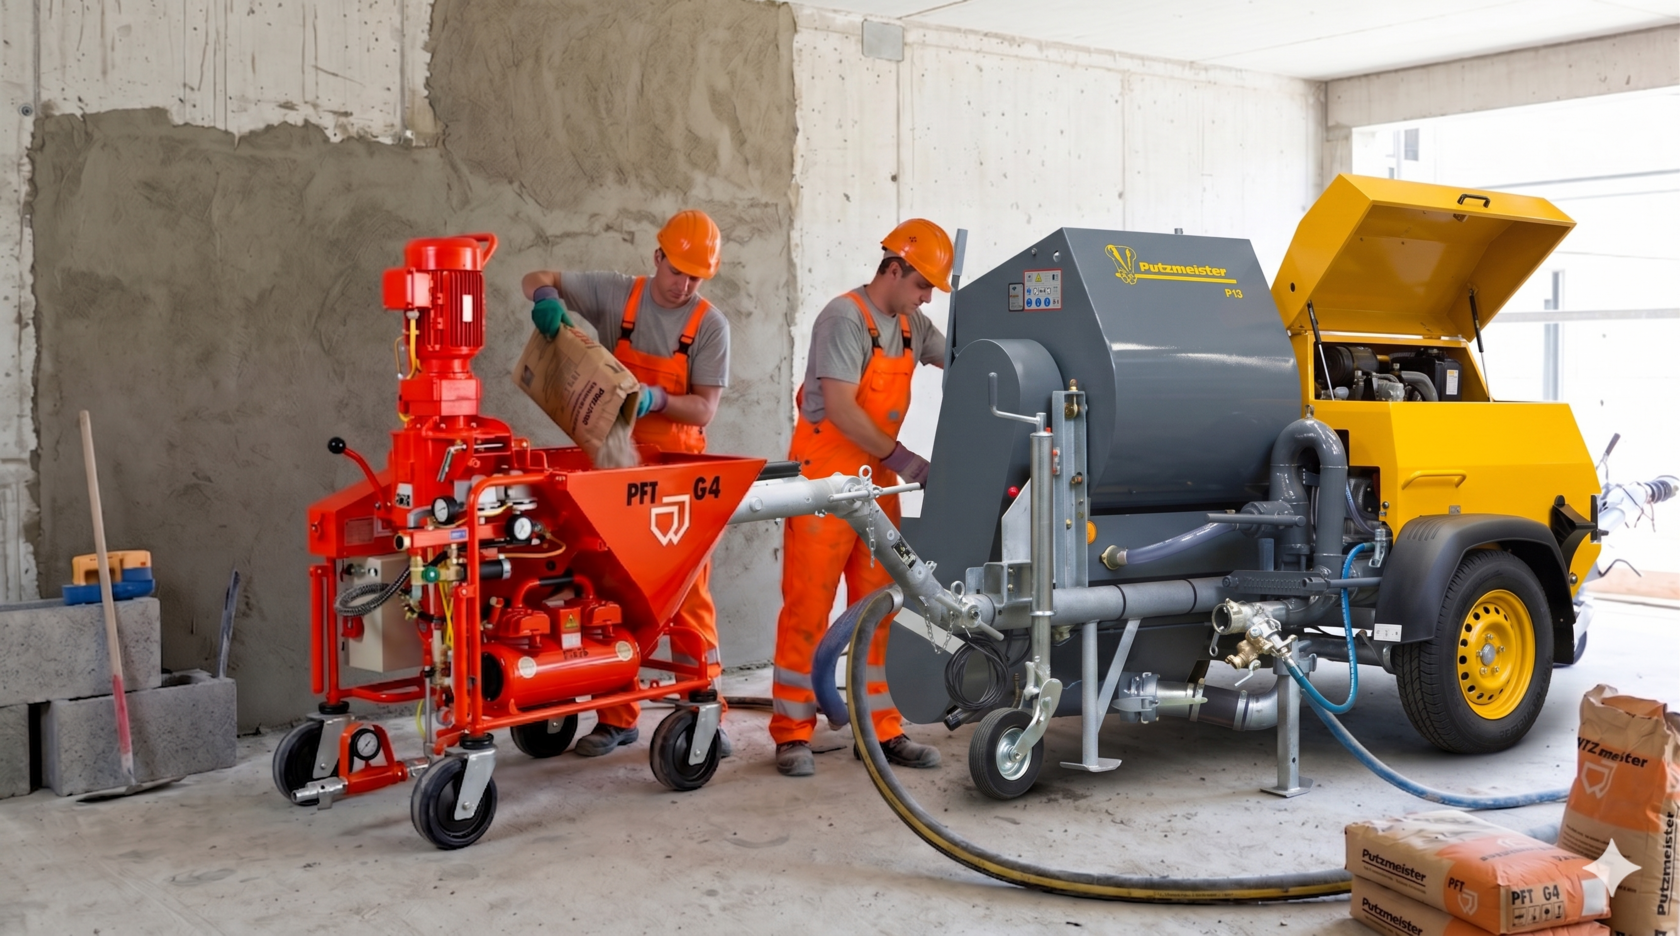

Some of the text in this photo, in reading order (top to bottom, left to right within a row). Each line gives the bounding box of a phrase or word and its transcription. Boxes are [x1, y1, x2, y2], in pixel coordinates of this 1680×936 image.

[1139, 262, 1227, 276] Putzmeister
[1224, 288, 1243, 299] P13
[626, 475, 721, 506] PFT G4
[1362, 848, 1427, 882] Putzmeister
[1657, 811, 1675, 916] Putzmeister
[1448, 877, 1465, 892] PFT
[1511, 884, 1560, 906] PFT G4
[1362, 897, 1423, 936] Putzmeister
